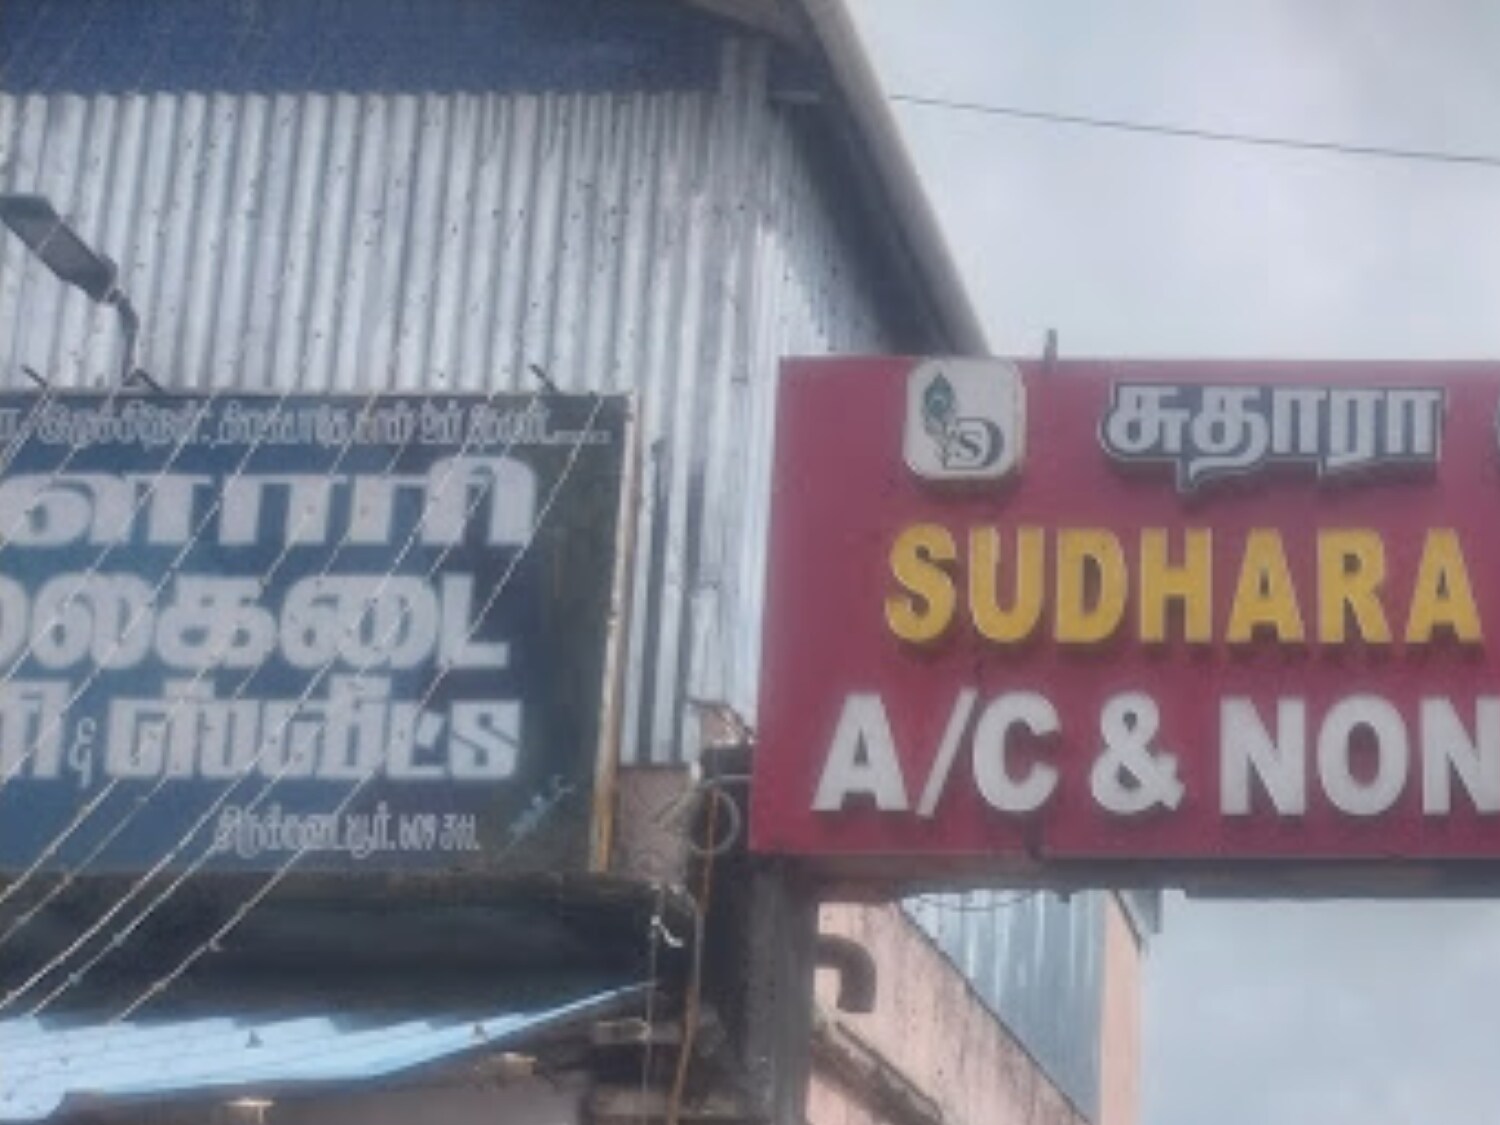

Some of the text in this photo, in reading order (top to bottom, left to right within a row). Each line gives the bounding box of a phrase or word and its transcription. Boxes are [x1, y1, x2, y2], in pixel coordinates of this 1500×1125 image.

[1100, 384, 1445, 484] சுதாரா
[884, 524, 1484, 646] SUDHARA
[811, 690, 1062, 820] A/C
[1089, 690, 1186, 814] &
